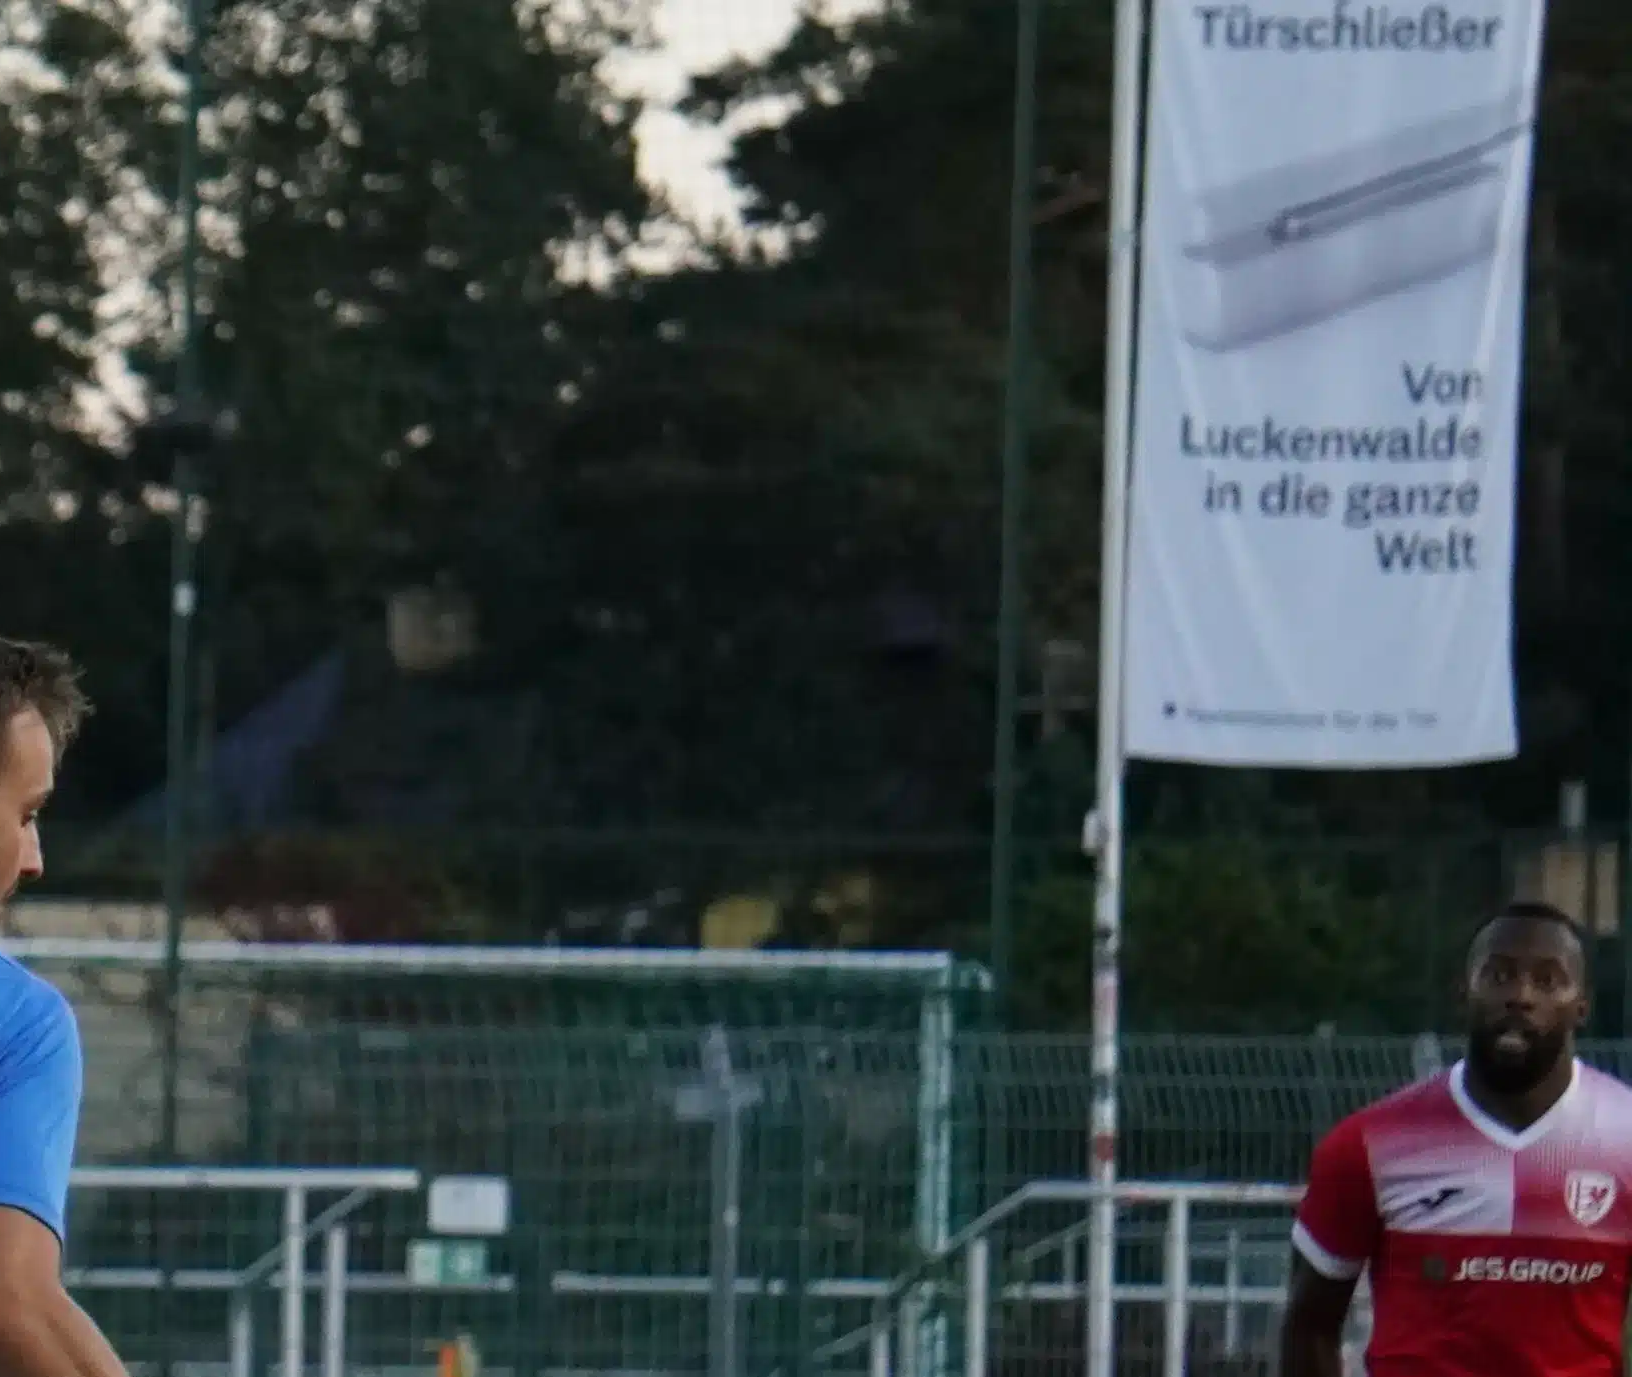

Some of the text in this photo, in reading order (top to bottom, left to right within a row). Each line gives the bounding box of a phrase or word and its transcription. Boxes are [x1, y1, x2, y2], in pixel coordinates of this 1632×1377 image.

[1193, 2, 1504, 53] Türschließer
[1400, 361, 1483, 402] Von
[1179, 415, 1484, 463] Luckenwalde
[1204, 472, 1481, 530] in die ganze
[1374, 530, 1478, 573] Welt
[1452, 1255, 1606, 1285] JES.GROUP
